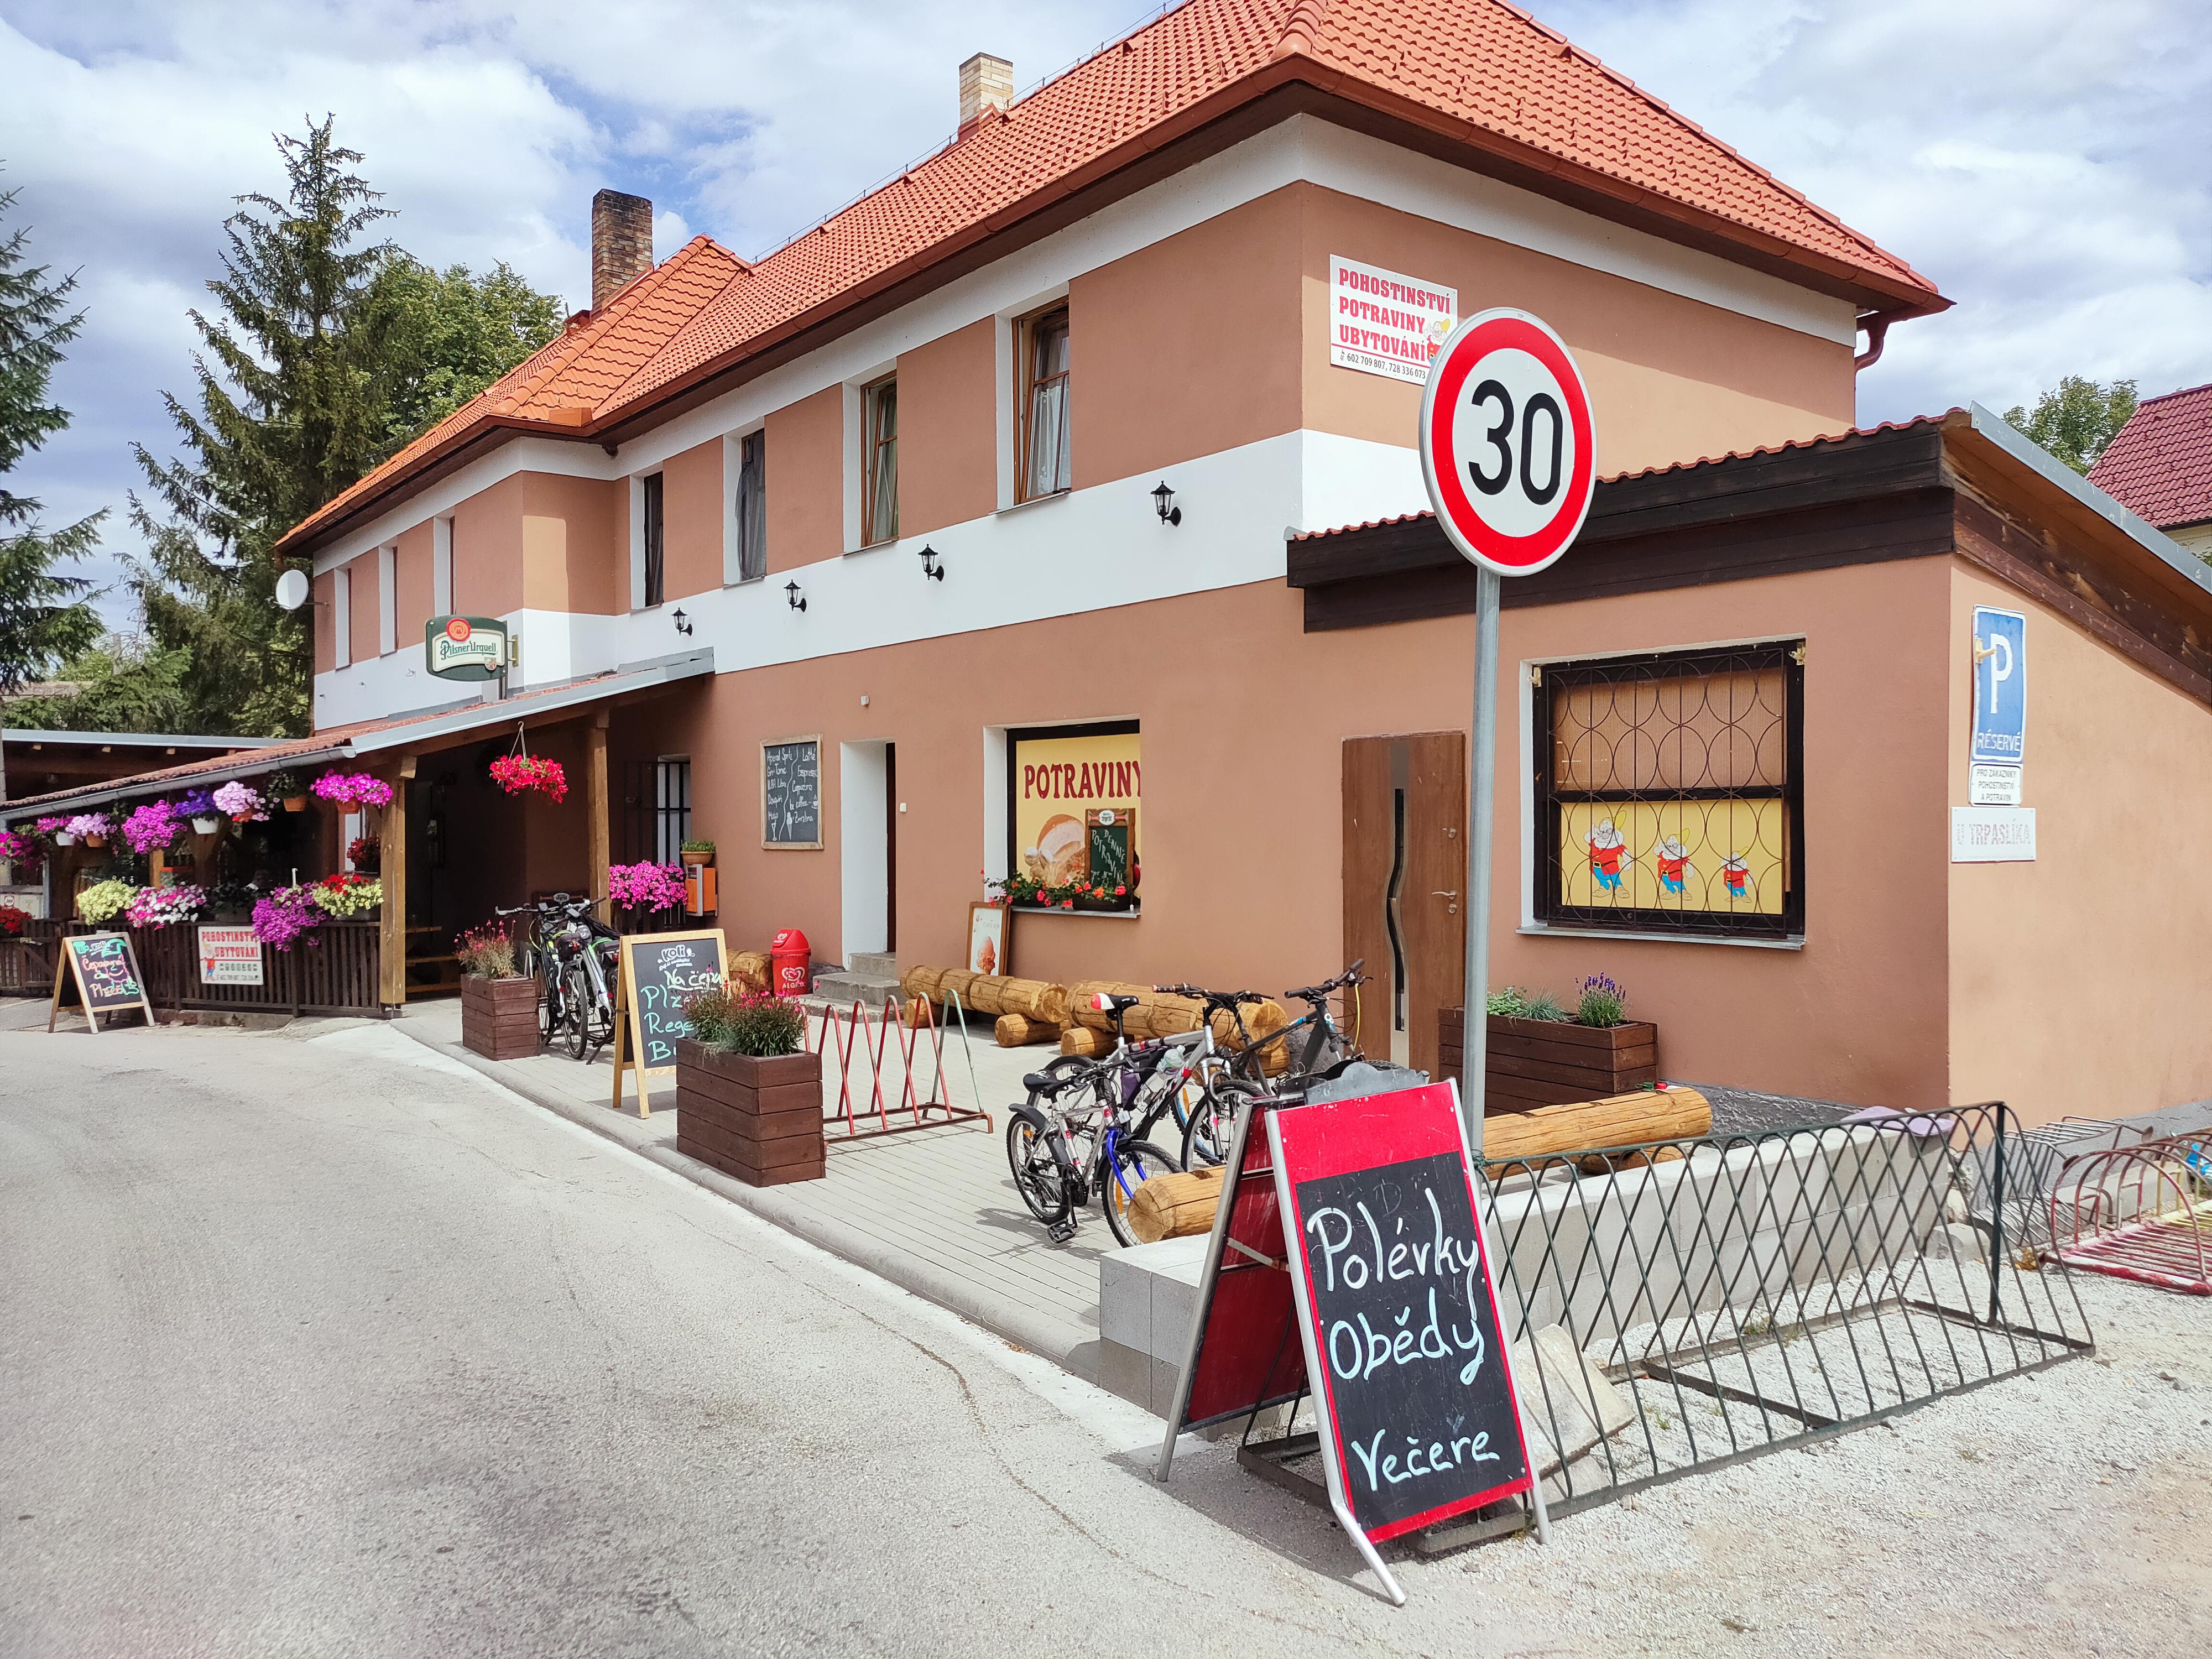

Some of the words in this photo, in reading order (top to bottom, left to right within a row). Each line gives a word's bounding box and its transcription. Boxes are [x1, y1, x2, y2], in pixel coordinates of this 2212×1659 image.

[1339, 268, 1451, 314] POHOSTINSTVÍ
[1339, 296, 1425, 334] POTRAVINY
[1339, 324, 1425, 361] UBYTOVÁNÍ
[1347, 352, 1359, 363] 602
[1361, 356, 1373, 366] 709
[1374, 359, 1387, 371] 807,
[1389, 363, 1400, 373] 728
[1402, 366, 1413, 376] 336
[1415, 369, 1426, 379] 073
[1469, 379, 1563, 505] 30
[440, 640, 470, 660] Pilsner
[469, 640, 496, 655] Urquell
[1991, 634, 2013, 713] P
[1977, 729, 2021, 753] RÉSERVÉ
[1978, 780, 2015, 790] POHOSTINSTVÍ
[664, 968, 685, 986] Na
[1307, 1188, 1479, 1321] Polévky
[1329, 1287, 1484, 1385] Obědy
